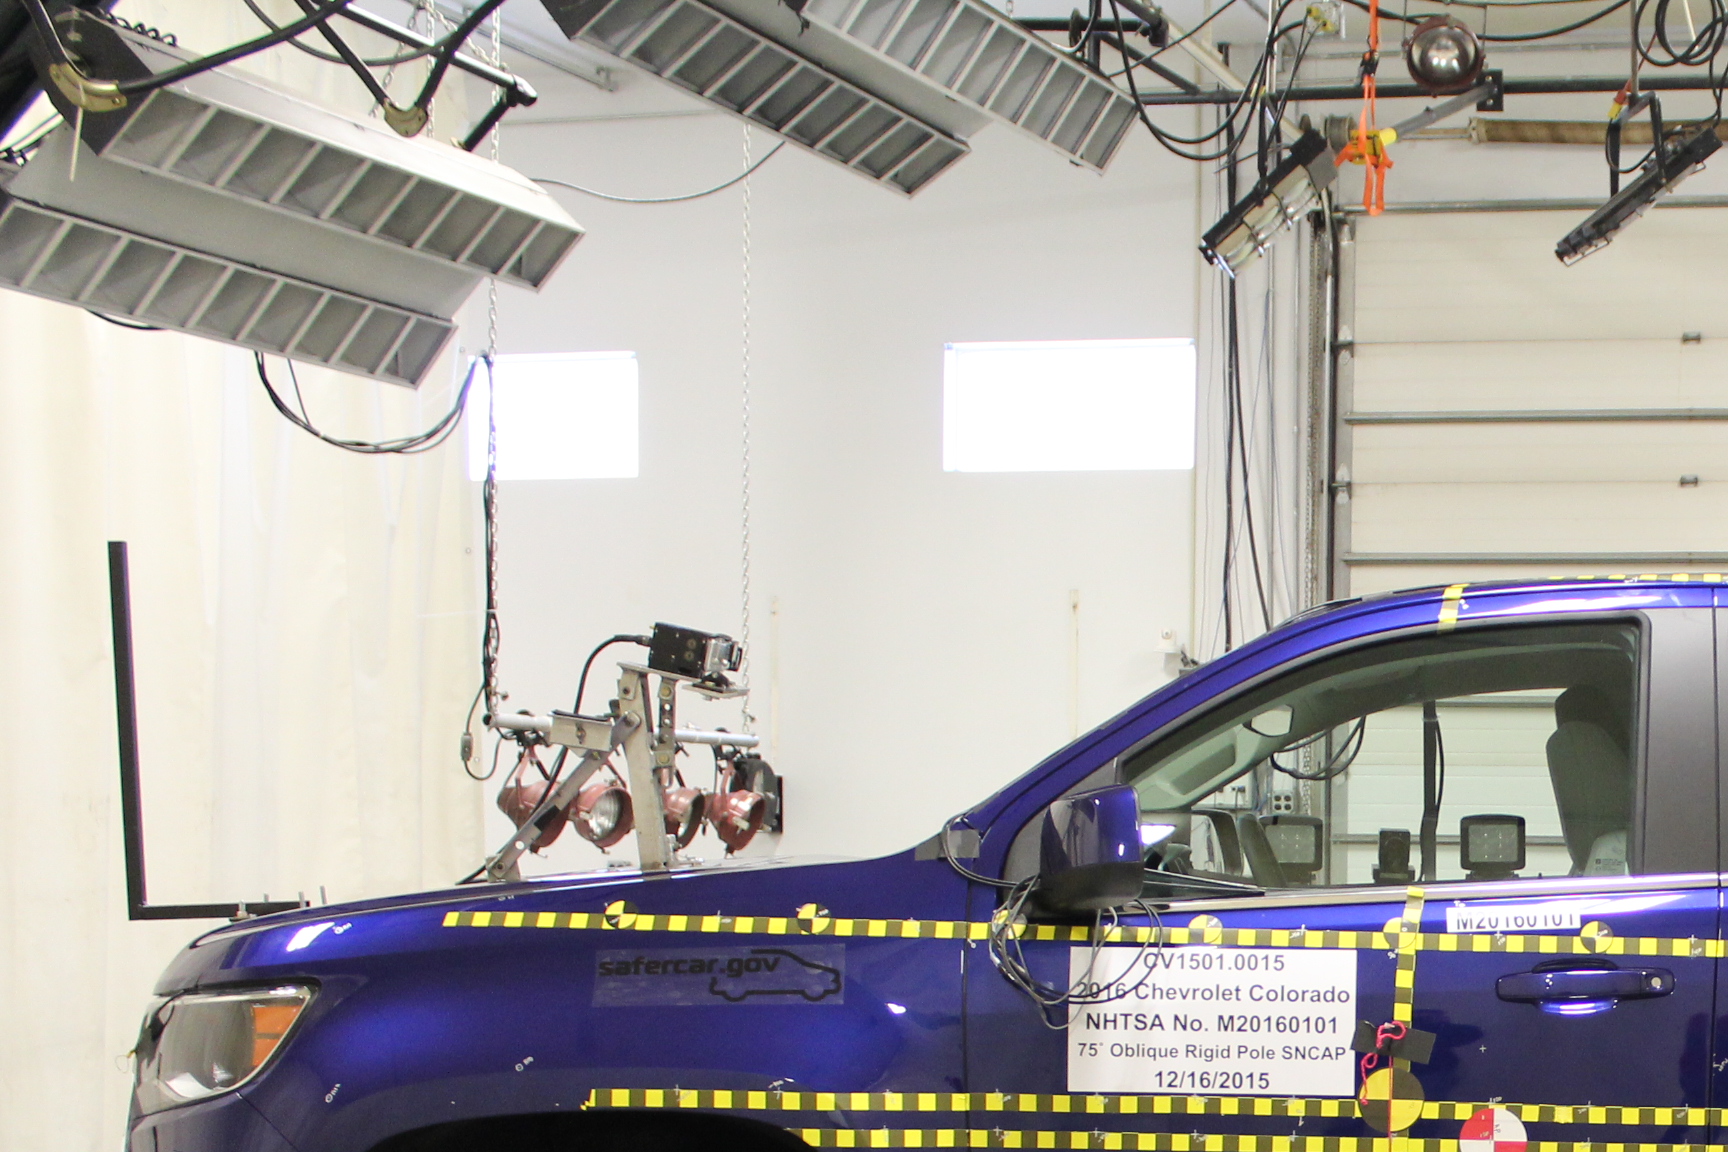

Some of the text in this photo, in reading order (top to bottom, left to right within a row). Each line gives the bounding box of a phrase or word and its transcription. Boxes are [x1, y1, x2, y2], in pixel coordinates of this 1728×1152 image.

[599, 955, 782, 979] safercar.gov
[1143, 952, 1286, 972] CV1501.0015
[1076, 981, 1351, 1004] 2016 Chevrolet Colorado
[1085, 1013, 1338, 1035] NHTSA No. M20160101
[1110, 1042, 1180, 1061] Oblique
[1185, 1044, 1232, 1063] Rigid
[1237, 1045, 1276, 1061] Pole
[1281, 1046, 1347, 1062] SNCAP
[1153, 1070, 1271, 1090] 12/16/2015
